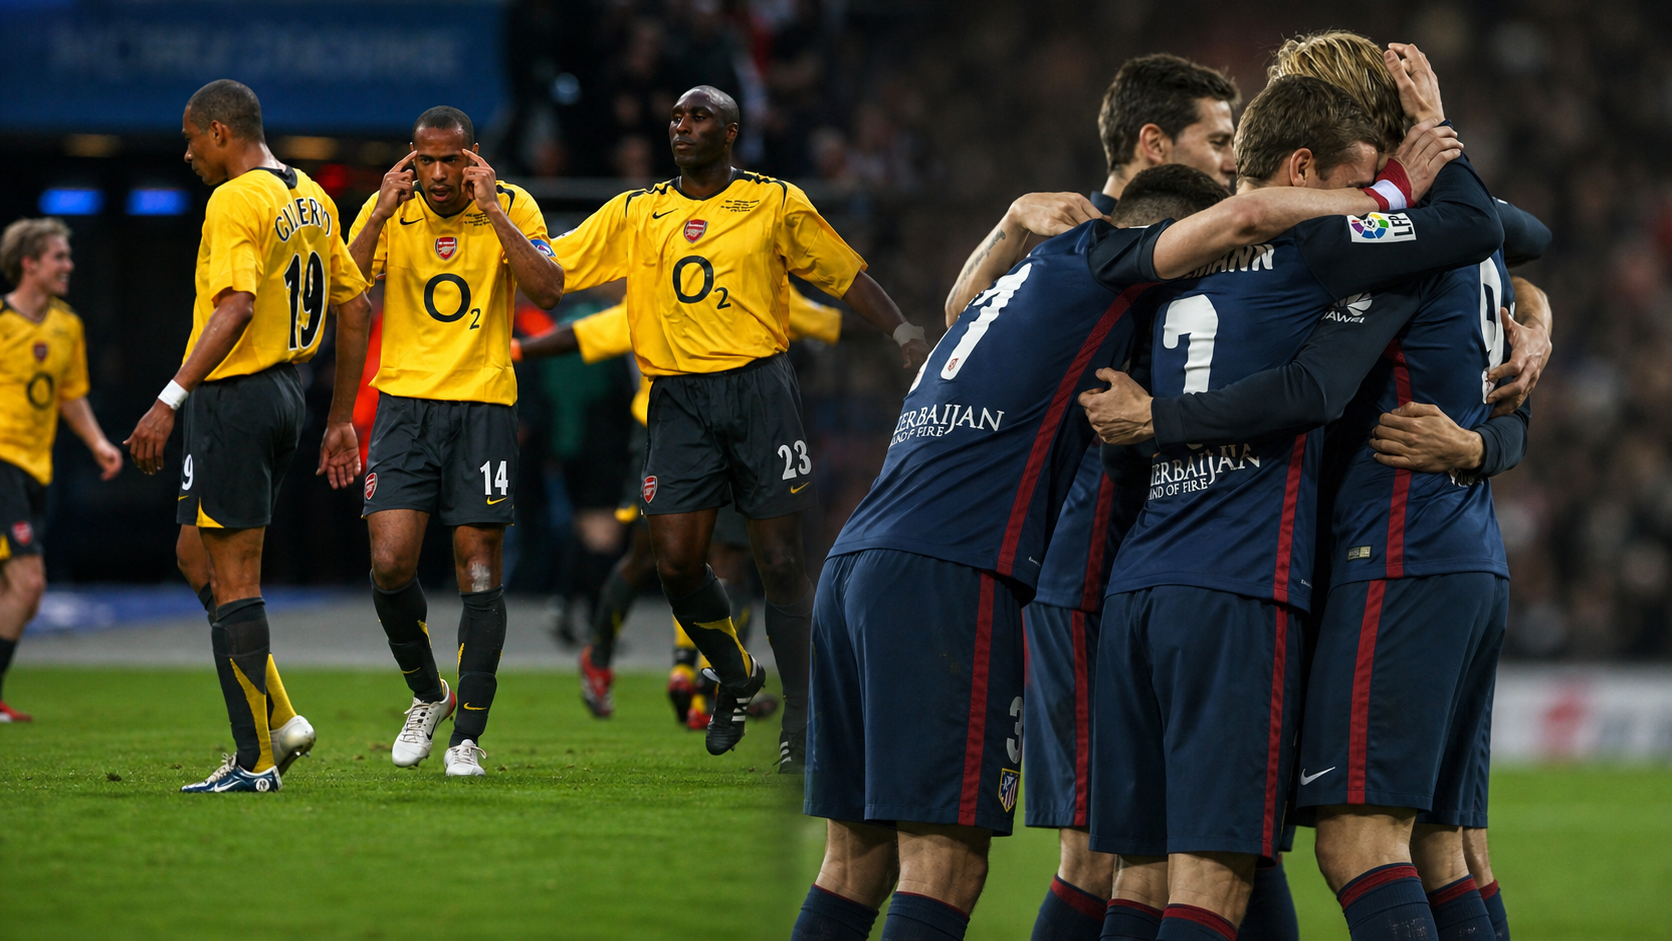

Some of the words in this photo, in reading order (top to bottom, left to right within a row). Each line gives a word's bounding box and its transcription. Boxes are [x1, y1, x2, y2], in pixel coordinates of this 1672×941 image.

[1388, 215, 1414, 237] LFP
[283, 250, 326, 351] 19
[423, 272, 481, 330] O2
[673, 255, 732, 310] O2
[1162, 293, 1219, 396] 7
[916, 425, 945, 438] FIRE
[479, 460, 509, 496] 14
[777, 439, 812, 481] 23
[1165, 483, 1180, 496] OF
[1182, 477, 1209, 494] FIRE
[1006, 695, 1025, 765] 3
